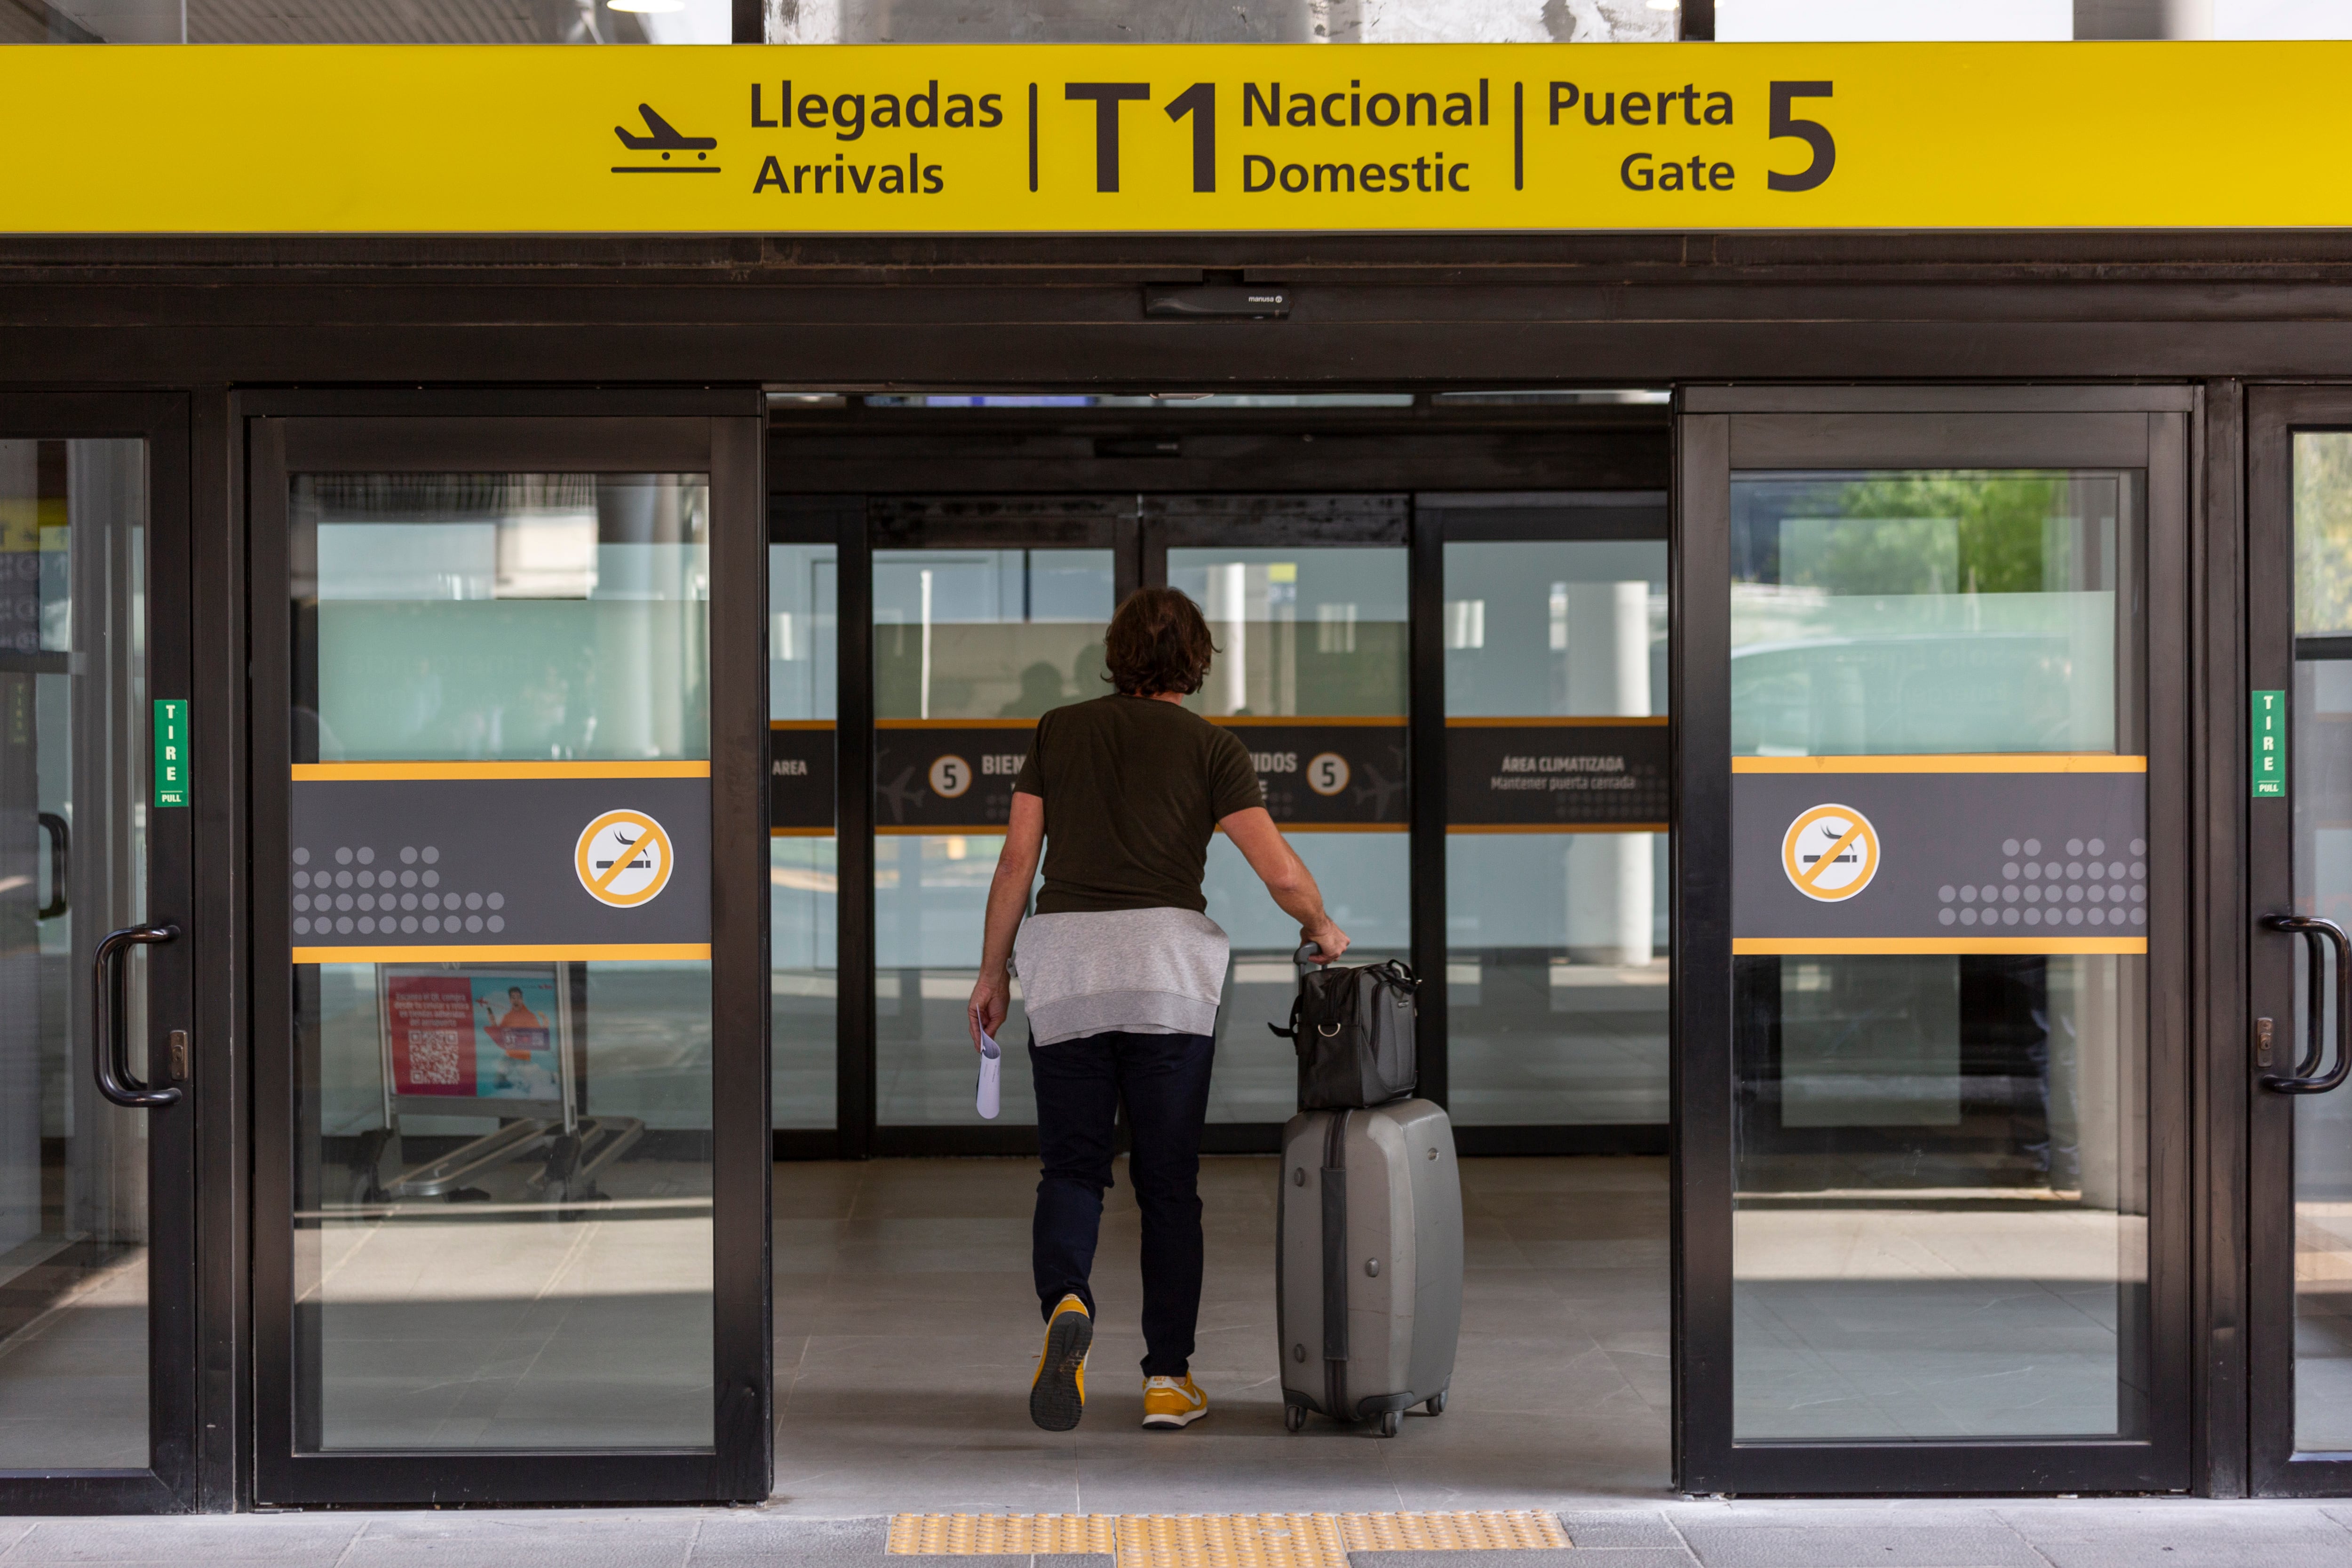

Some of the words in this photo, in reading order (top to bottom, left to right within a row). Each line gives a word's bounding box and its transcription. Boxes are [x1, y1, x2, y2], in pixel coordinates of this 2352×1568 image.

[752, 80, 1003, 142] Llegadas
[1244, 79, 1489, 127] Nacional
[1550, 81, 1733, 127] Puerta
[1065, 83, 1216, 193] T1
[1767, 80, 1836, 193] 5
[753, 153, 944, 194] Arrivals
[1244, 152, 1470, 193] Domestic
[1621, 153, 1735, 192] Gate
[166, 705, 176, 781] TIRE
[2264, 695, 2274, 771] TIRE
[772, 760, 808, 776] AREA
[944, 764, 958, 791] 5
[1322, 762, 1336, 788] 5
[1491, 776, 1548, 790] Mantener
[1549, 777, 1589, 792] puerta
[1590, 776, 1637, 790] cerrada
[1539, 756, 1625, 772] CLIMATIZADA
[161, 794, 182, 803] PULL
[2259, 784, 2279, 792] PULL
